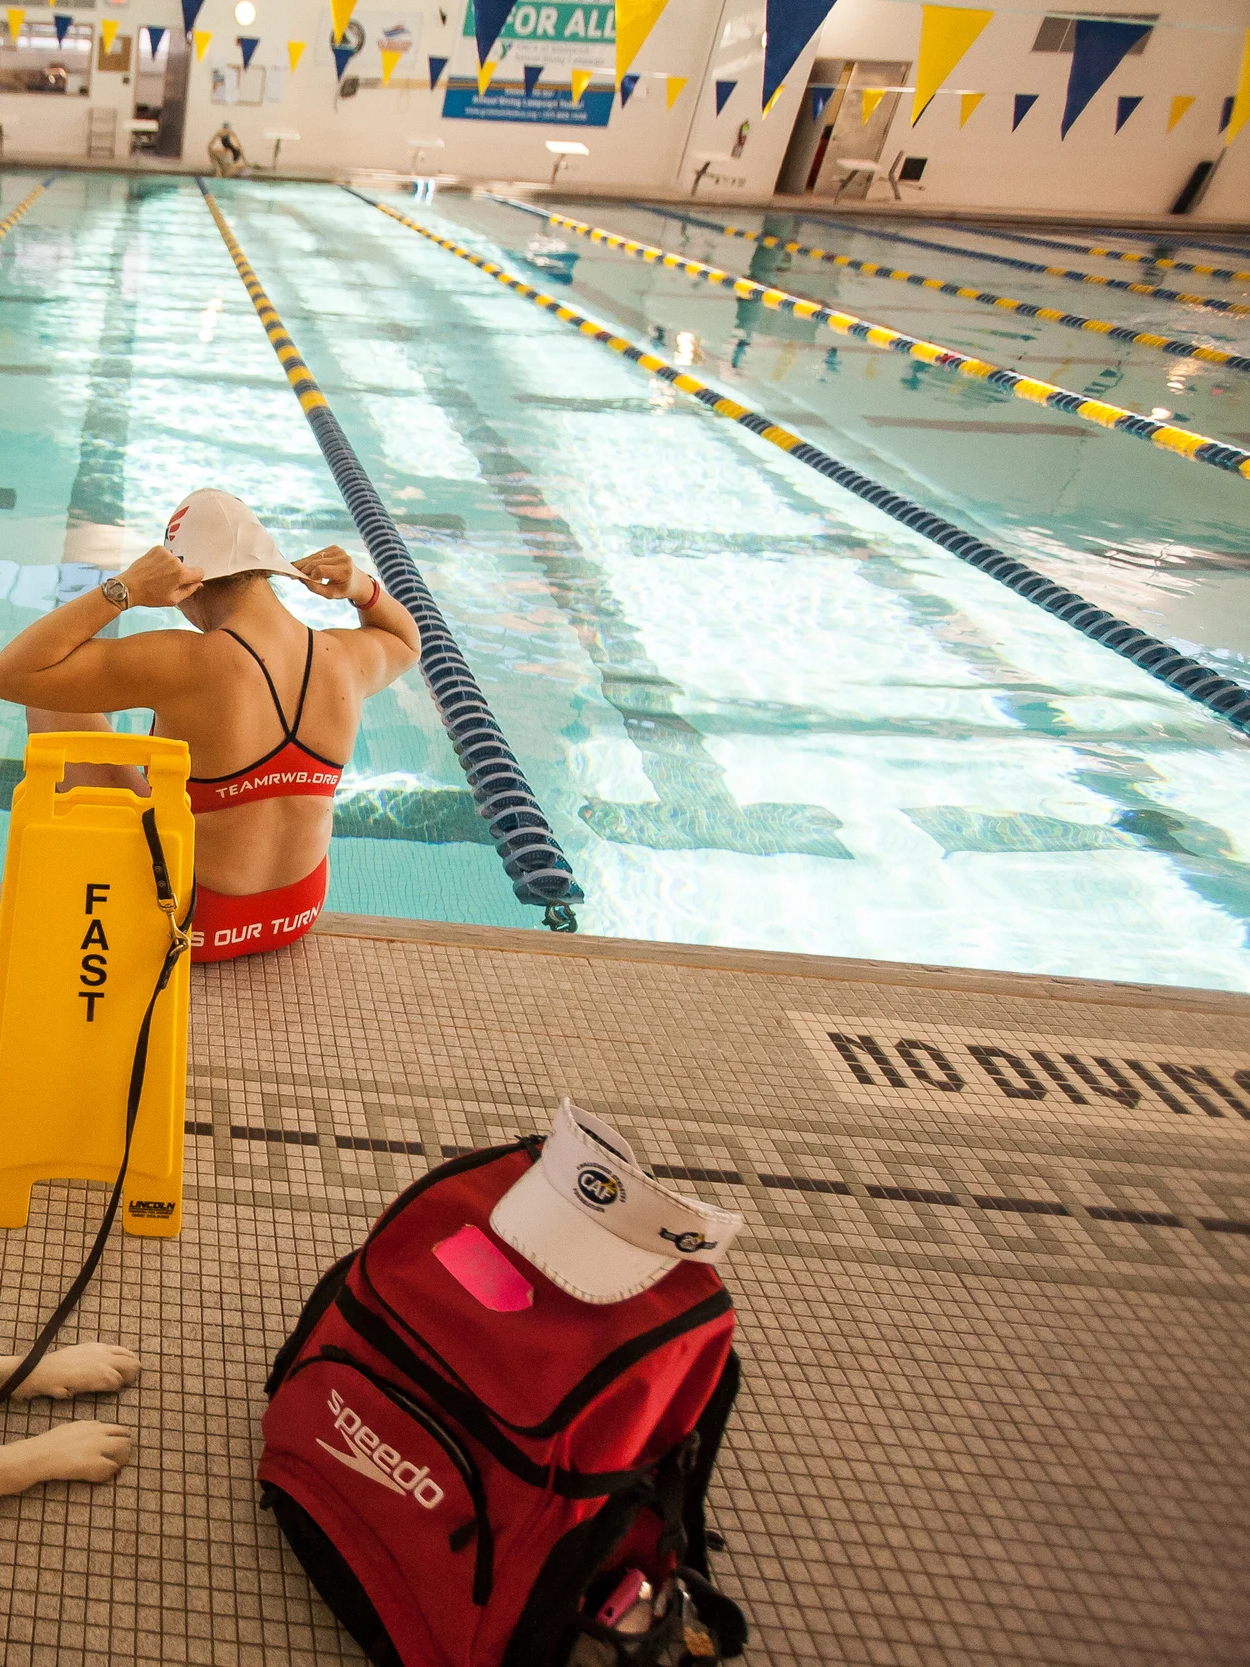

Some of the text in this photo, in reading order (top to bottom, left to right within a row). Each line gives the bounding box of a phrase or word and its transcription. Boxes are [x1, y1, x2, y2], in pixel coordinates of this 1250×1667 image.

[563, 8, 616, 40] ALL
[215, 771, 339, 799] TEAMRWB.ORG
[214, 923, 262, 947] OUR
[271, 901, 321, 935] TURN
[78, 883, 111, 1022] FAST
[826, 1032, 1250, 1121] NO DIVIN
[130, 1200, 176, 1210] LINCOLN
[581, 1173, 614, 1200] CAF
[327, 1388, 444, 1510] speedo
